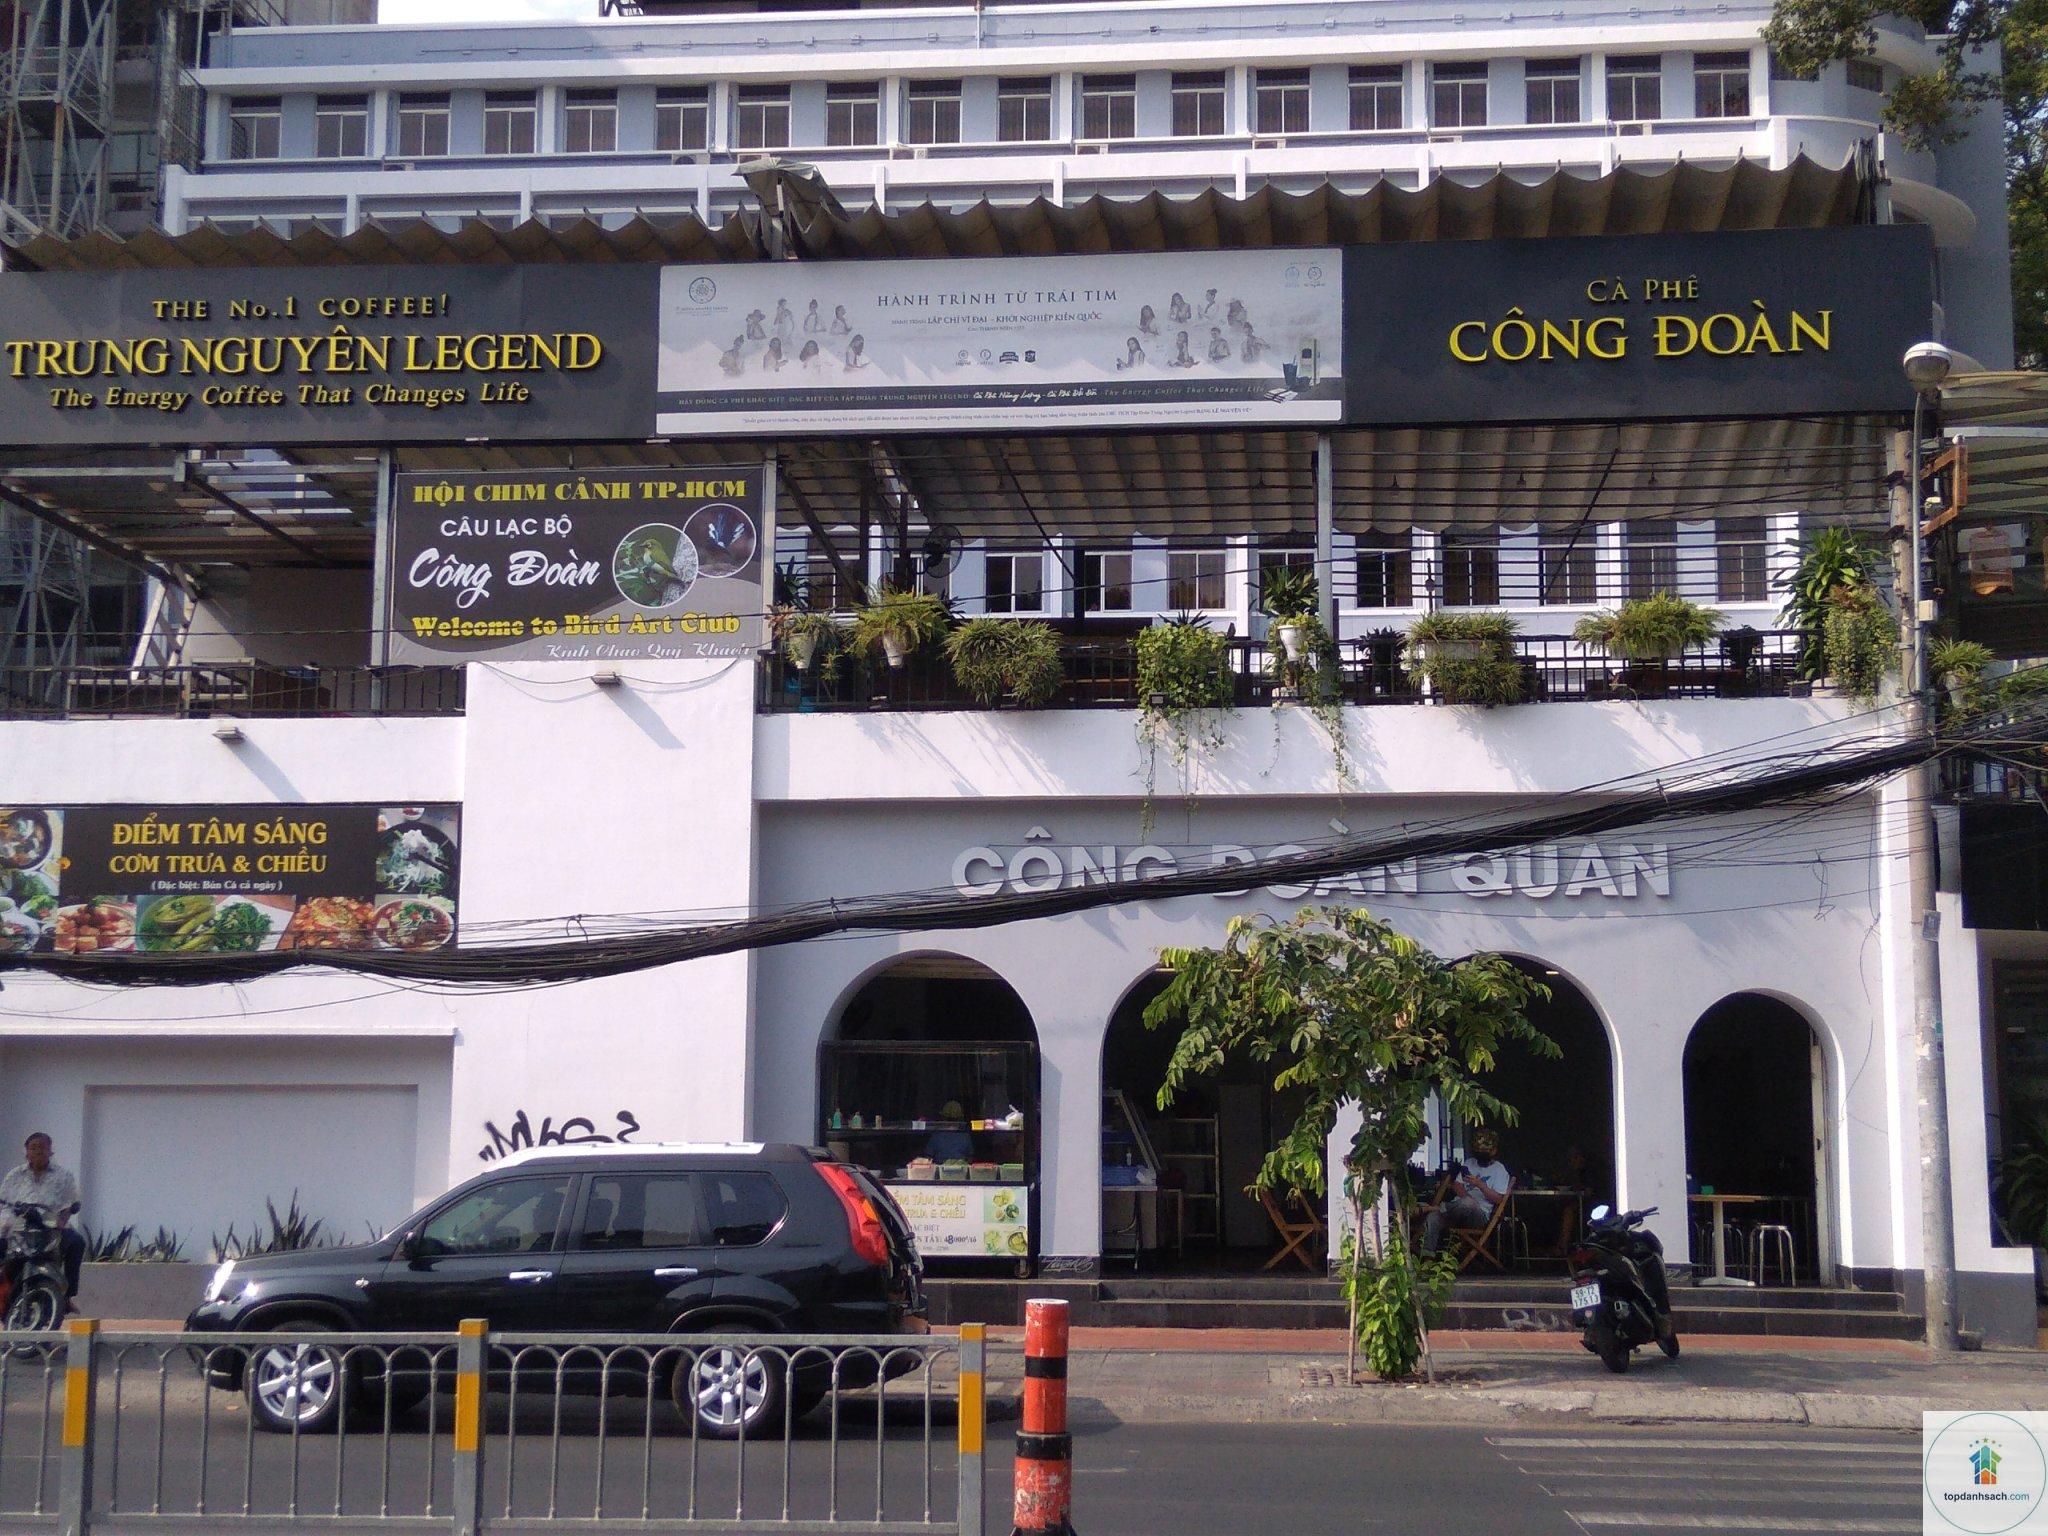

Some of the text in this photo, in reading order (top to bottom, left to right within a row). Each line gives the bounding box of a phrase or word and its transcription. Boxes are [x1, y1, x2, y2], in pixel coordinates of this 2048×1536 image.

[877, 292, 929, 307] HÀNH
[938, 290, 996, 305] TRÌNH
[1035, 288, 1076, 303] TRÁI
[1084, 289, 1118, 301] TIM
[1587, 274, 1700, 302] CÀ PHÊ
[153, 294, 451, 318] THE No.1 COFFEE!
[1448, 300, 1833, 363] CÔNG ĐOÀN
[5, 326, 602, 376] TRUNG NGUYÊN LEGEND
[50, 381, 530, 411] The Energy Coffee That Changes Life
[413, 476, 747, 508] HỘI CHIM CẢNH TP.HCM
[440, 514, 572, 540] CÂU LẠC BỘ
[409, 547, 601, 608] Công Đoàn
[412, 612, 742, 638] Welcome to Bird Art Club
[113, 812, 328, 846] ĐIỂM TÂM SÁNG
[109, 846, 327, 874] CƠM TRƯA & CHIỀU
[952, 825, 1182, 897] CÔNG
